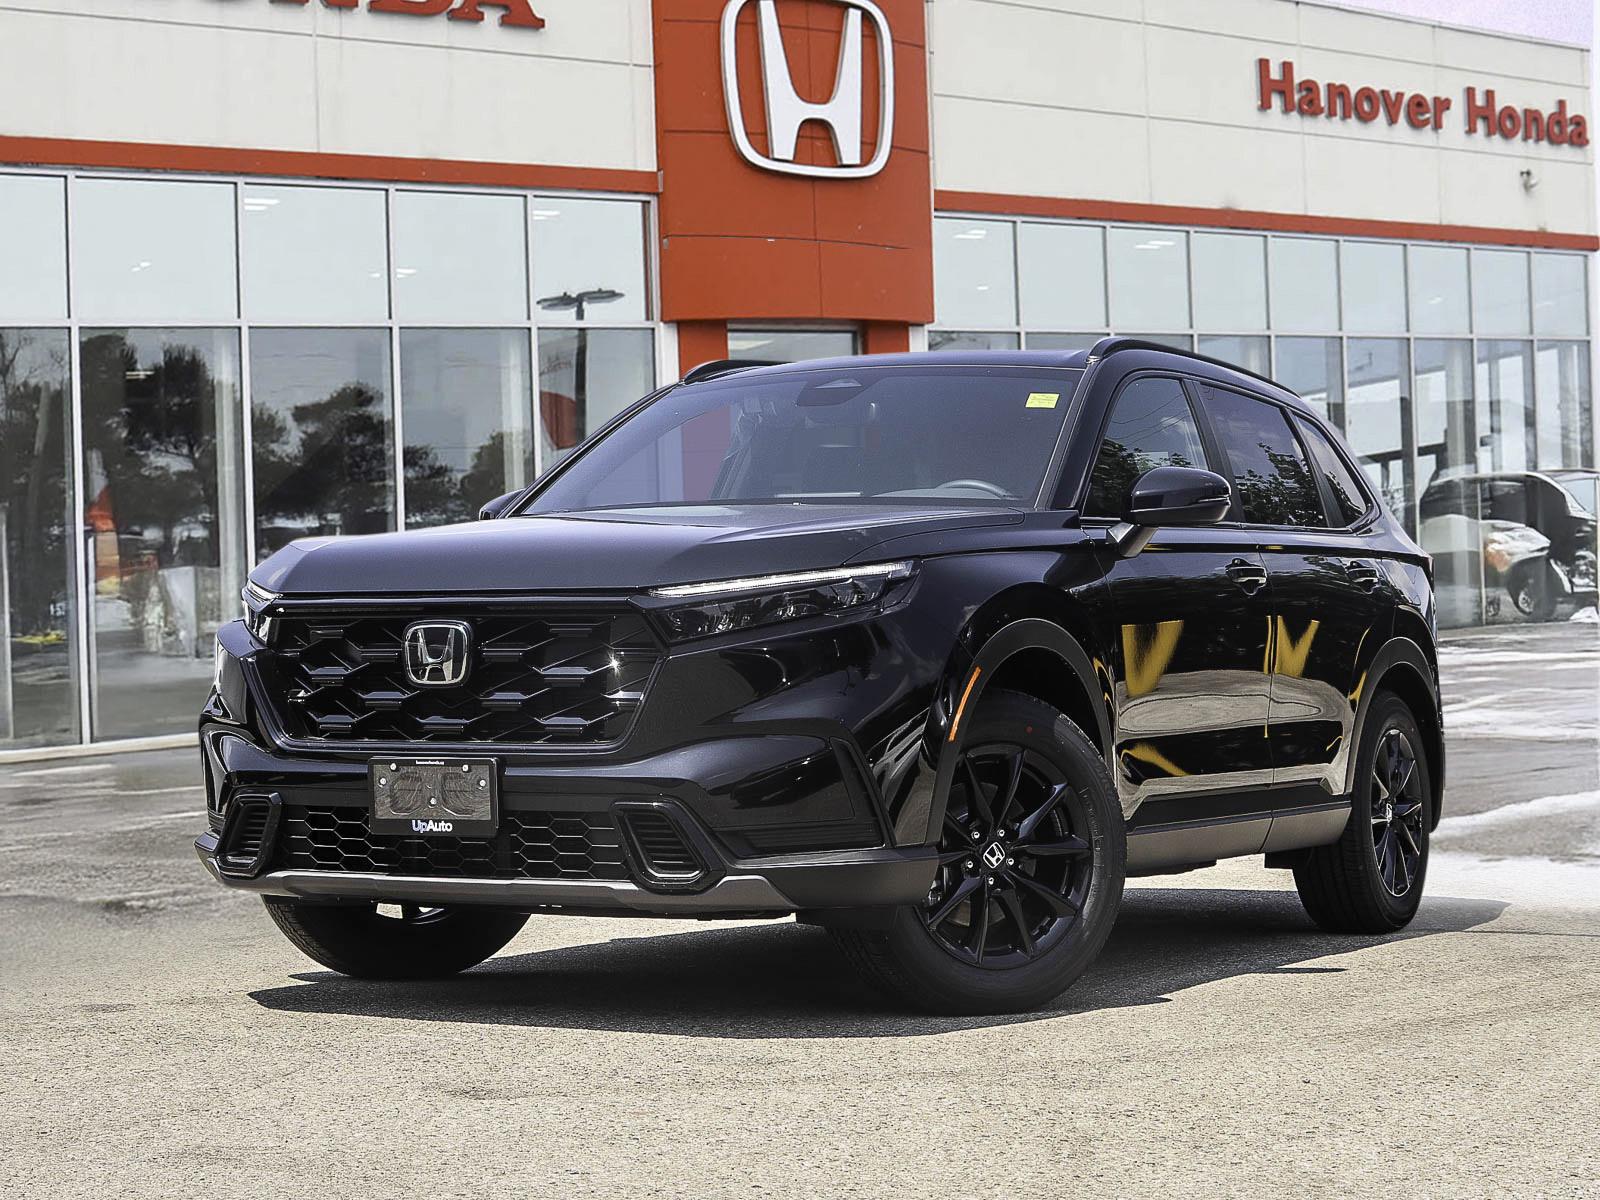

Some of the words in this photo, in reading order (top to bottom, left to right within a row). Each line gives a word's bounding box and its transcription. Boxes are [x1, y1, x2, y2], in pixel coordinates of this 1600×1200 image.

[1258, 57, 1451, 130] Hanover
[1465, 86, 1590, 147] Honda
[412, 819, 453, 834] UpAuto
